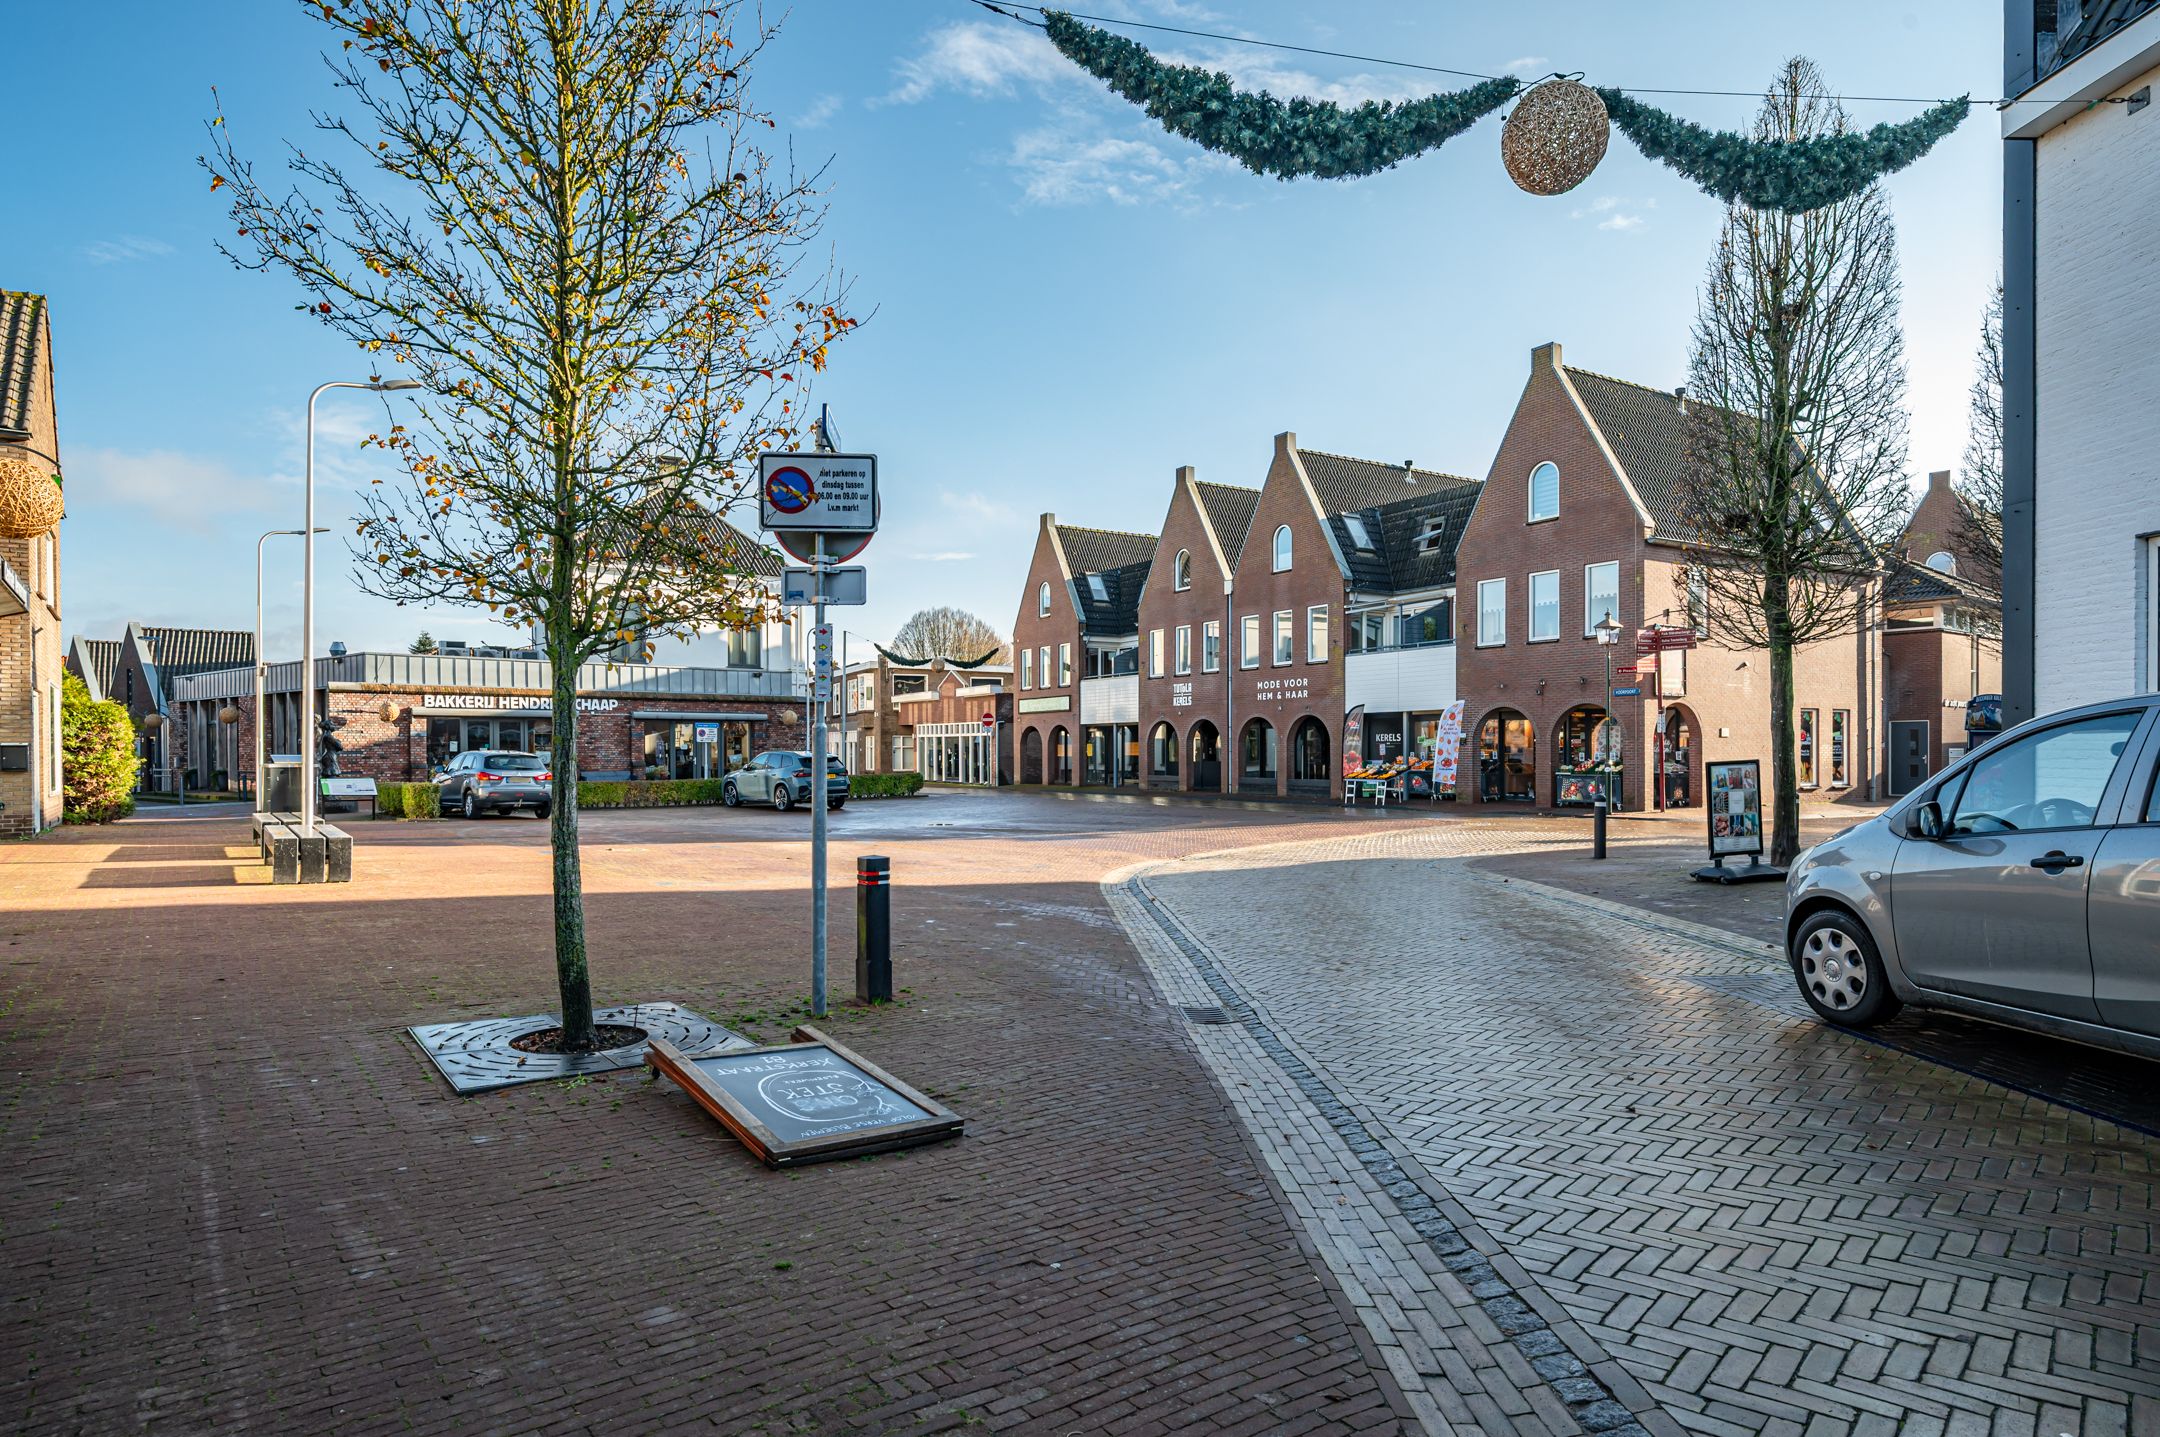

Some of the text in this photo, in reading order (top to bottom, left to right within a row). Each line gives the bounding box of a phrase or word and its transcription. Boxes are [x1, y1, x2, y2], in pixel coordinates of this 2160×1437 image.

[820, 469, 866, 479] niet parkeren op
[822, 481, 844, 490] dinsdag
[843, 492, 858, 500] 09.00
[1257, 678, 1308, 690] MODE VOOR
[1257, 689, 1308, 701] HEM & HAAR
[424, 694, 495, 709] BAKKERIJ
[498, 697, 553, 710] HENDRI
[1375, 733, 1402, 742] KERELS
[760, 1055, 786, 1064] 81
[716, 1057, 834, 1076] KERKSTRAAT
[777, 1082, 844, 1100] STEK
[800, 1123, 852, 1138] BLOEMEN
